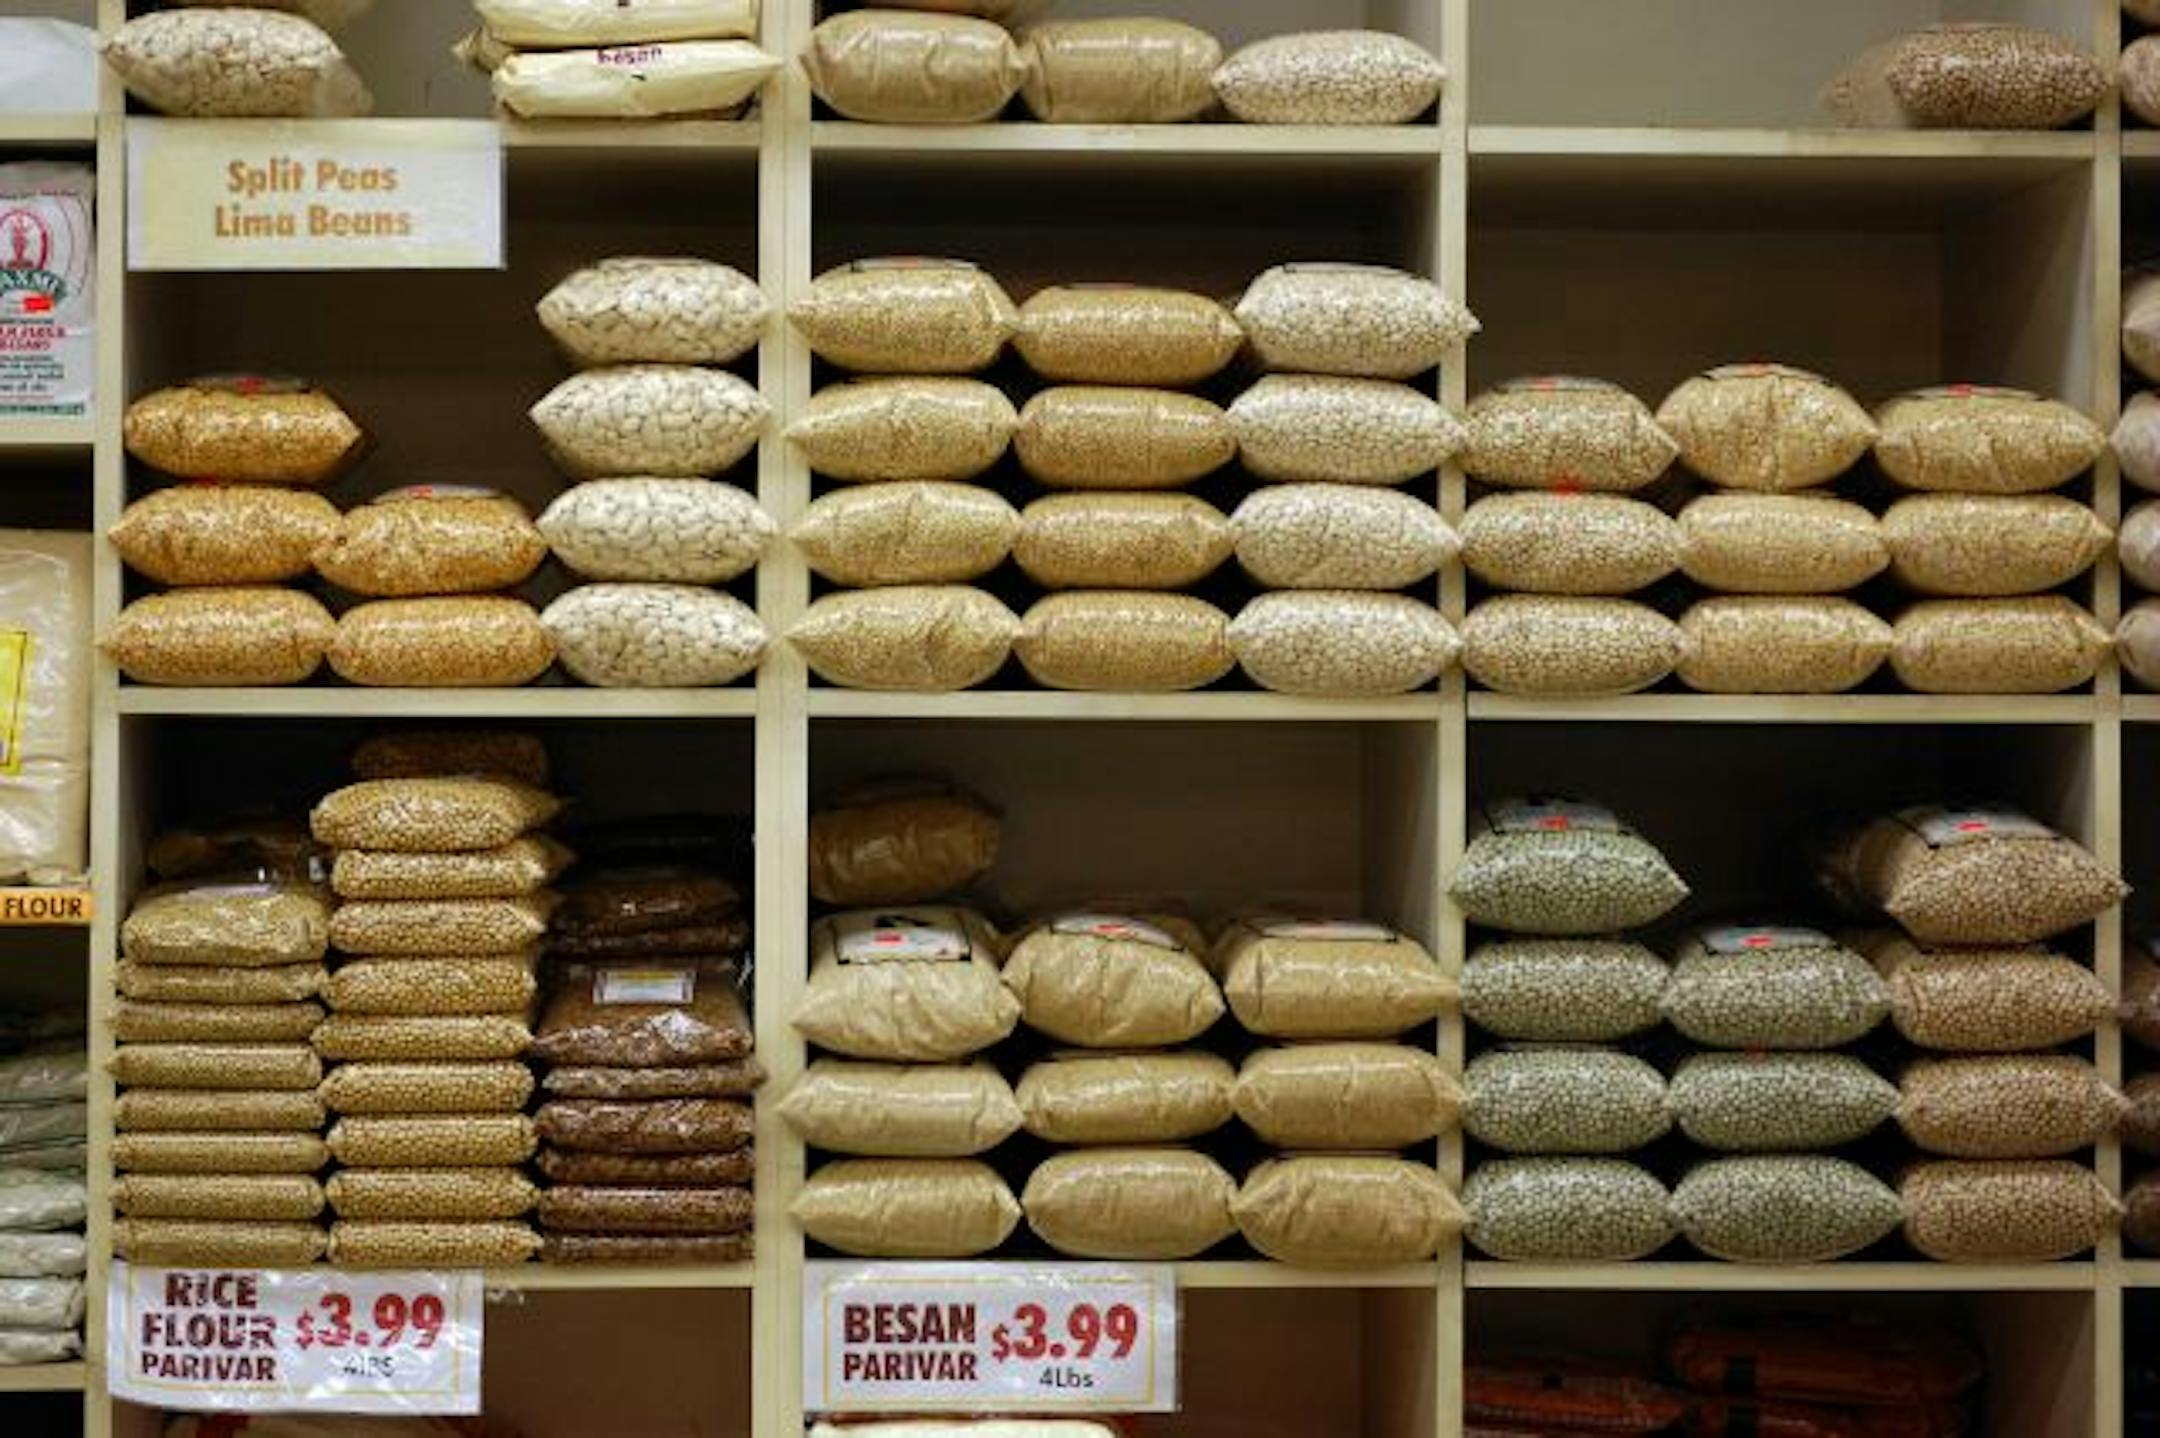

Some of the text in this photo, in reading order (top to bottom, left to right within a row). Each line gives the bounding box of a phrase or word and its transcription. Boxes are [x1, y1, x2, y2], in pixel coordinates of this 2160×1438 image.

[228, 156, 398, 197] Split Peas
[215, 202, 412, 237] Lima Beans
[5, 897, 82, 918] FLOUR
[165, 1273, 257, 1309] RICE
[141, 1312, 277, 1349] FLOUR
[295, 1293, 446, 1350] $3.99
[843, 1304, 976, 1344] BESAN
[991, 1303, 1138, 1362] $3.99
[141, 1352, 276, 1381] PARIVAR
[843, 1353, 978, 1381] PARIVAR
[1039, 1367, 1094, 1388] 4Lbs
